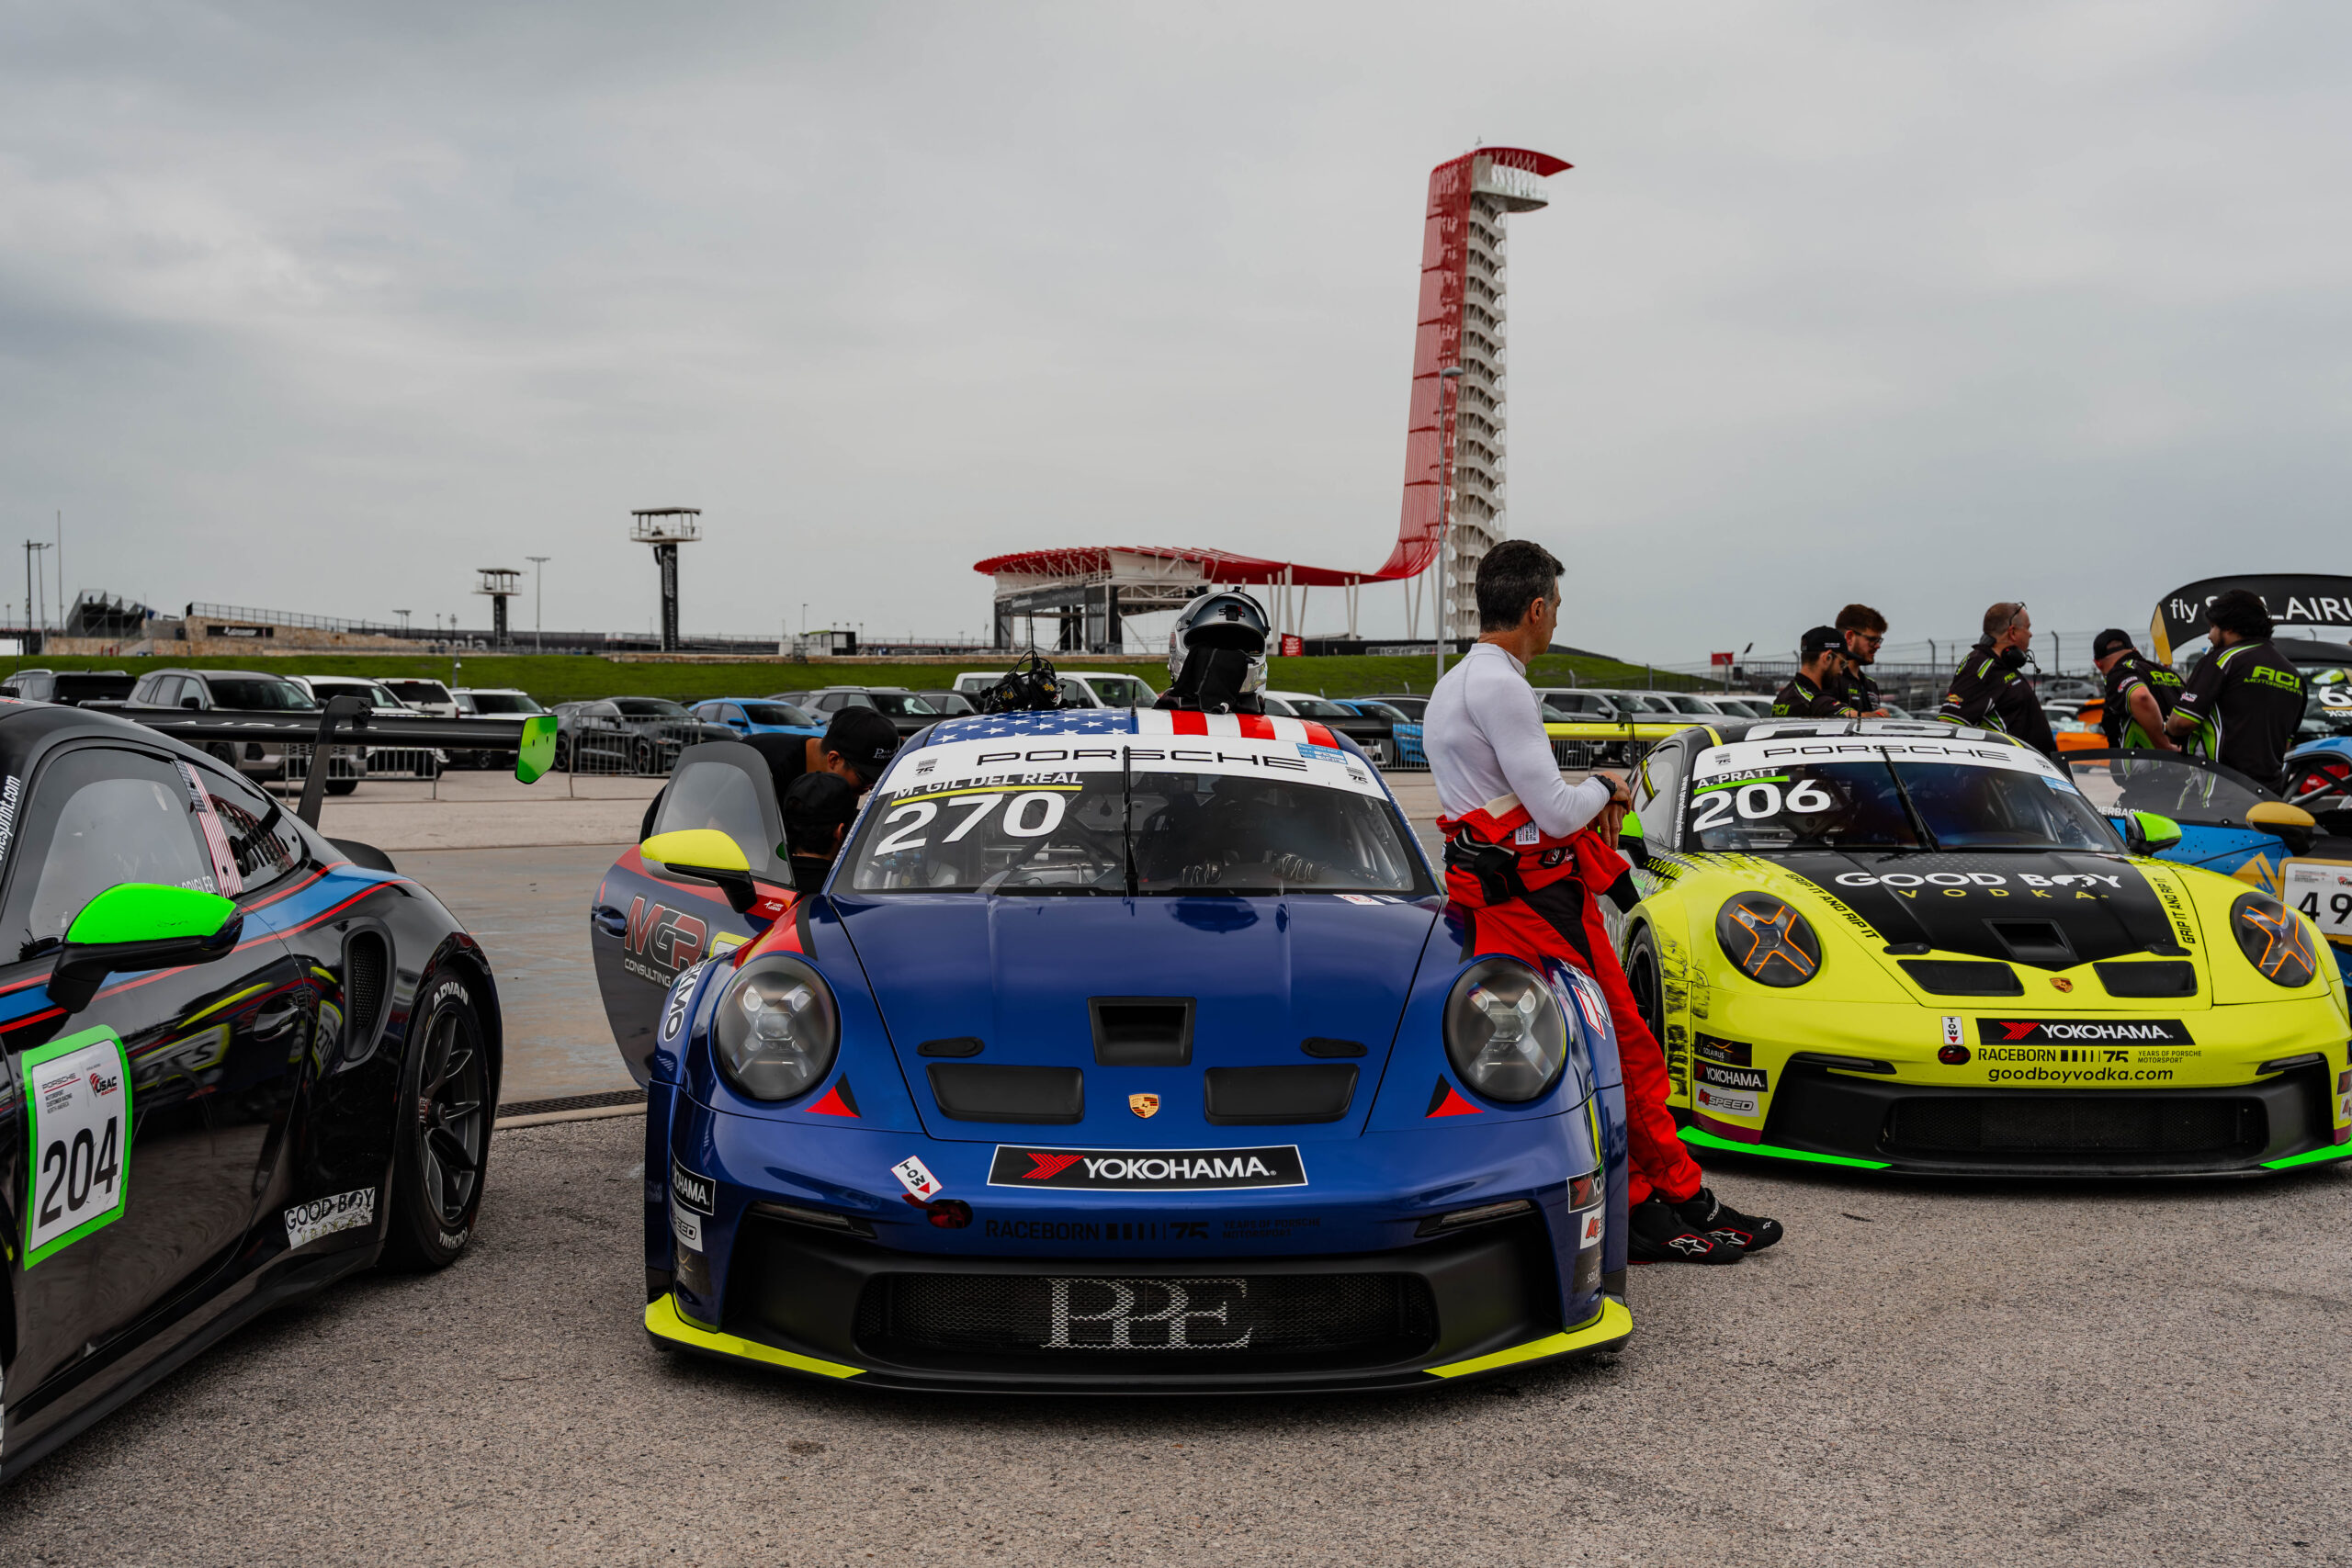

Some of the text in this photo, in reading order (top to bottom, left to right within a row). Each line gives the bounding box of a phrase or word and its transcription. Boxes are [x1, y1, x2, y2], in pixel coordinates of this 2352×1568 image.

[2170, 598, 2199, 624] fly
[2252, 665, 2300, 689] ACI
[977, 749, 1308, 772] PORSCHE
[1763, 744, 2012, 761] PORSCHE
[893, 772, 1083, 800] M. GIL DEL REAL
[1696, 768, 1780, 789] A. PRATT
[1690, 779, 1831, 833] 206
[874, 791, 1067, 857] 270
[1836, 872, 2122, 887] GOOD BOY
[1898, 888, 2097, 899] VODKA
[2164, 894, 2183, 910] AND
[1784, 874, 1881, 939] GRIP IT AND RIP IT
[2172, 910, 2188, 919] IT
[2176, 920, 2197, 944] GRIP
[624, 958, 672, 987] CONSULTING
[434, 982, 469, 1010] ADVAN
[1947, 1017, 1958, 1035] TOW
[2040, 1024, 2169, 1039] YOKOHAMA
[1978, 1048, 2129, 1062] RACEBORN 75
[96, 1076, 118, 1093] USAC
[1706, 1066, 1762, 1088] YOKOHAMA
[1988, 1067, 2174, 1083] goodboyvodka.com
[39, 1115, 118, 1229] 204
[899, 1161, 926, 1187] TOW
[1083, 1156, 1270, 1179] YOKOHAMA
[286, 1189, 375, 1230] GOOD BOY
[986, 1220, 1209, 1240] RACEBORN 75
[1222, 1228, 1294, 1239] MOTORSPORT
[1223, 1217, 1321, 1230] YEARS OF PORSCHE
